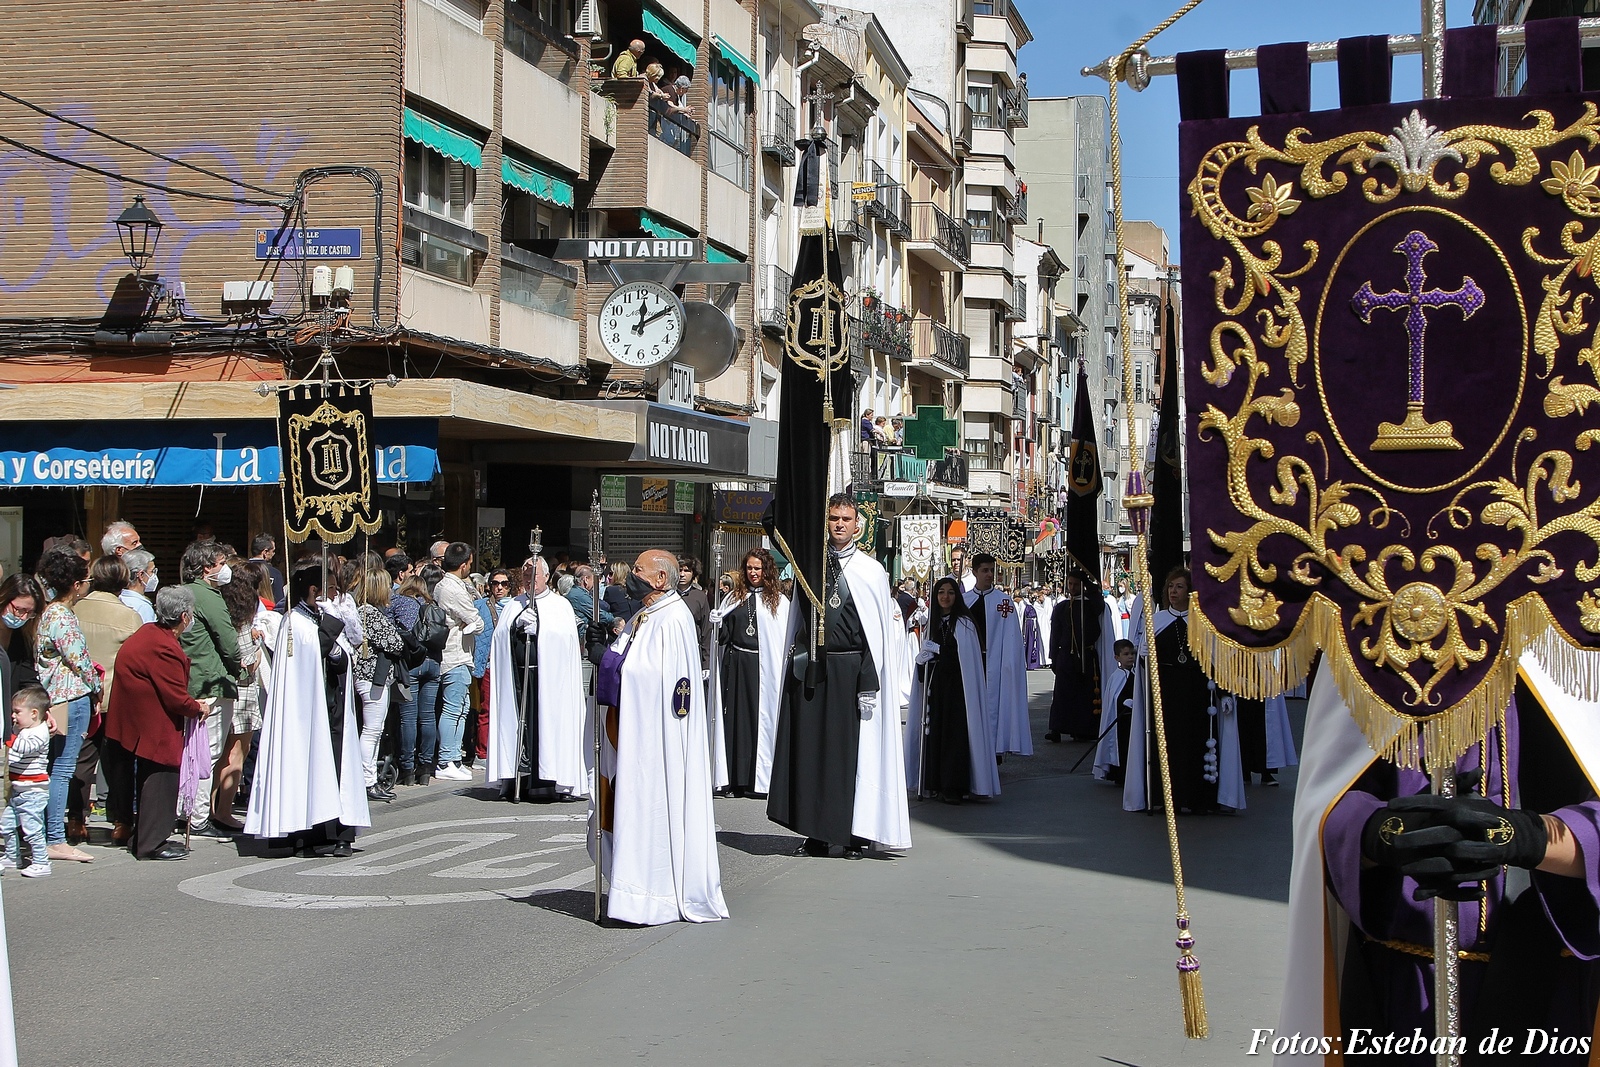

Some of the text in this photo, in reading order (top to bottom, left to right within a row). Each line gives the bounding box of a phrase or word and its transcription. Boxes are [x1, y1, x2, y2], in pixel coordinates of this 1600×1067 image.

[852, 186, 876, 194] VENDE
[320, 245, 328, 255] DE
[328, 245, 351, 255] CASTRO
[588, 240, 694, 257] NOTARIO
[623, 293, 632, 303] 11
[636, 289, 649, 300] 12
[655, 294, 660, 304] 1
[612, 305, 623, 316] 10
[609, 319, 617, 330] 9
[665, 320, 674, 330] 3
[612, 333, 620, 343] 8
[661, 333, 671, 344] 4
[623, 344, 632, 355] 7
[637, 349, 645, 360] 6
[650, 344, 660, 355] 5
[650, 421, 709, 464] NOTARIO
[211, 432, 261, 482] La
[12, 457, 26, 483] y
[33, 452, 156, 480] Corsetería
[727, 492, 763, 505] Fotos
[722, 506, 764, 520] Carne
[738, 526, 763, 535] KODAK
